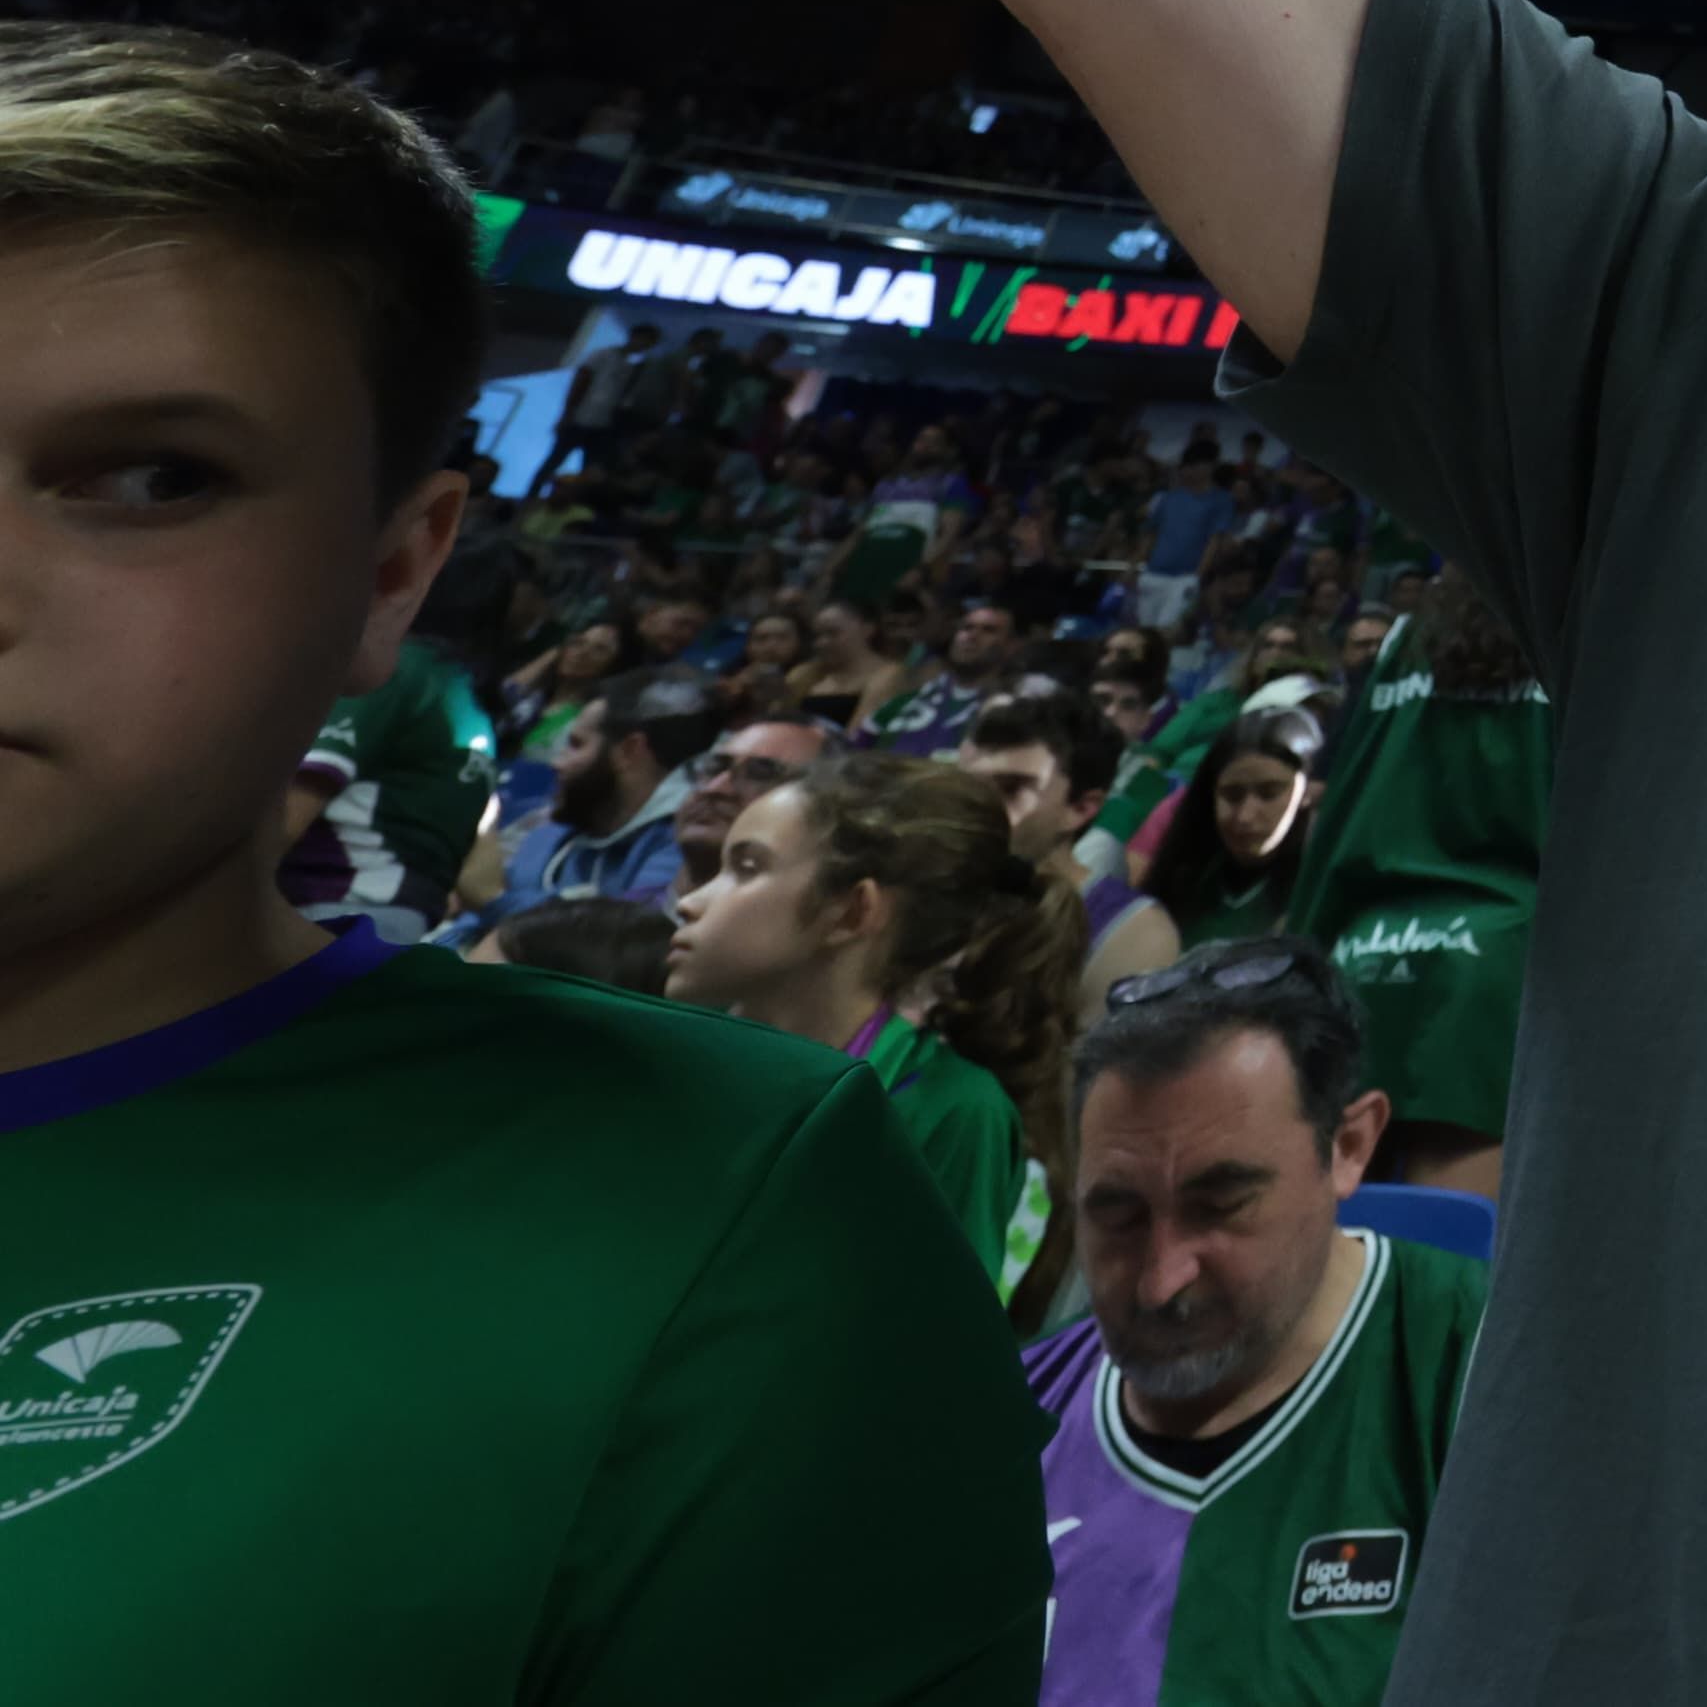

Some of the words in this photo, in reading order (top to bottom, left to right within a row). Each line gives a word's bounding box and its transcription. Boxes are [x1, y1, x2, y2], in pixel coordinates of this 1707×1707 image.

[567, 228, 937, 328] UNICAJA
[1004, 281, 1204, 347] BAXI
[0, 1384, 140, 1423] Unicaja
[1304, 1558, 1350, 1585] liga
[1300, 1578, 1393, 1606] endesa
